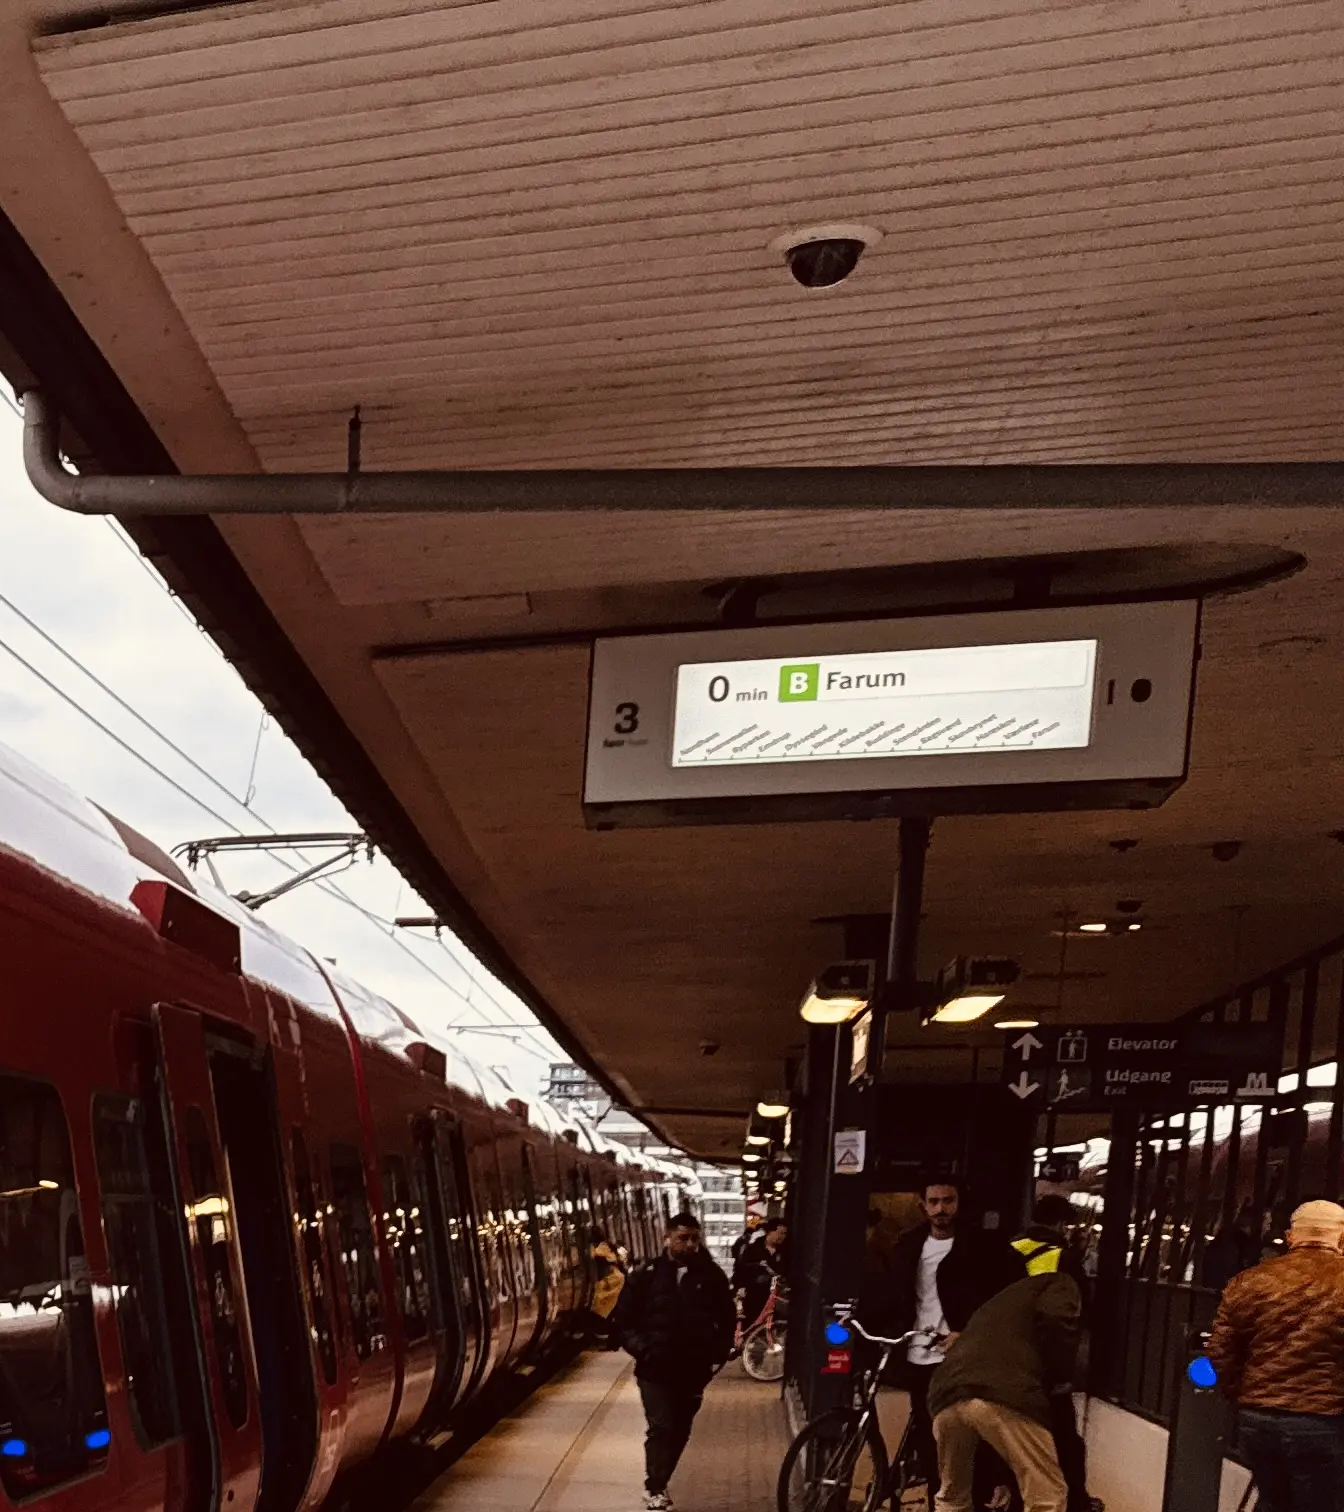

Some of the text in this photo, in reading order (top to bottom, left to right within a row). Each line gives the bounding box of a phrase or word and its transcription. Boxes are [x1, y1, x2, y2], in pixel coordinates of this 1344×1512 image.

[708, 671, 906, 703] 0 min B Farum
[614, 702, 639, 734] 3
[1107, 1037, 1179, 1051] Elevator
[1105, 1068, 1172, 1084] Udgang
